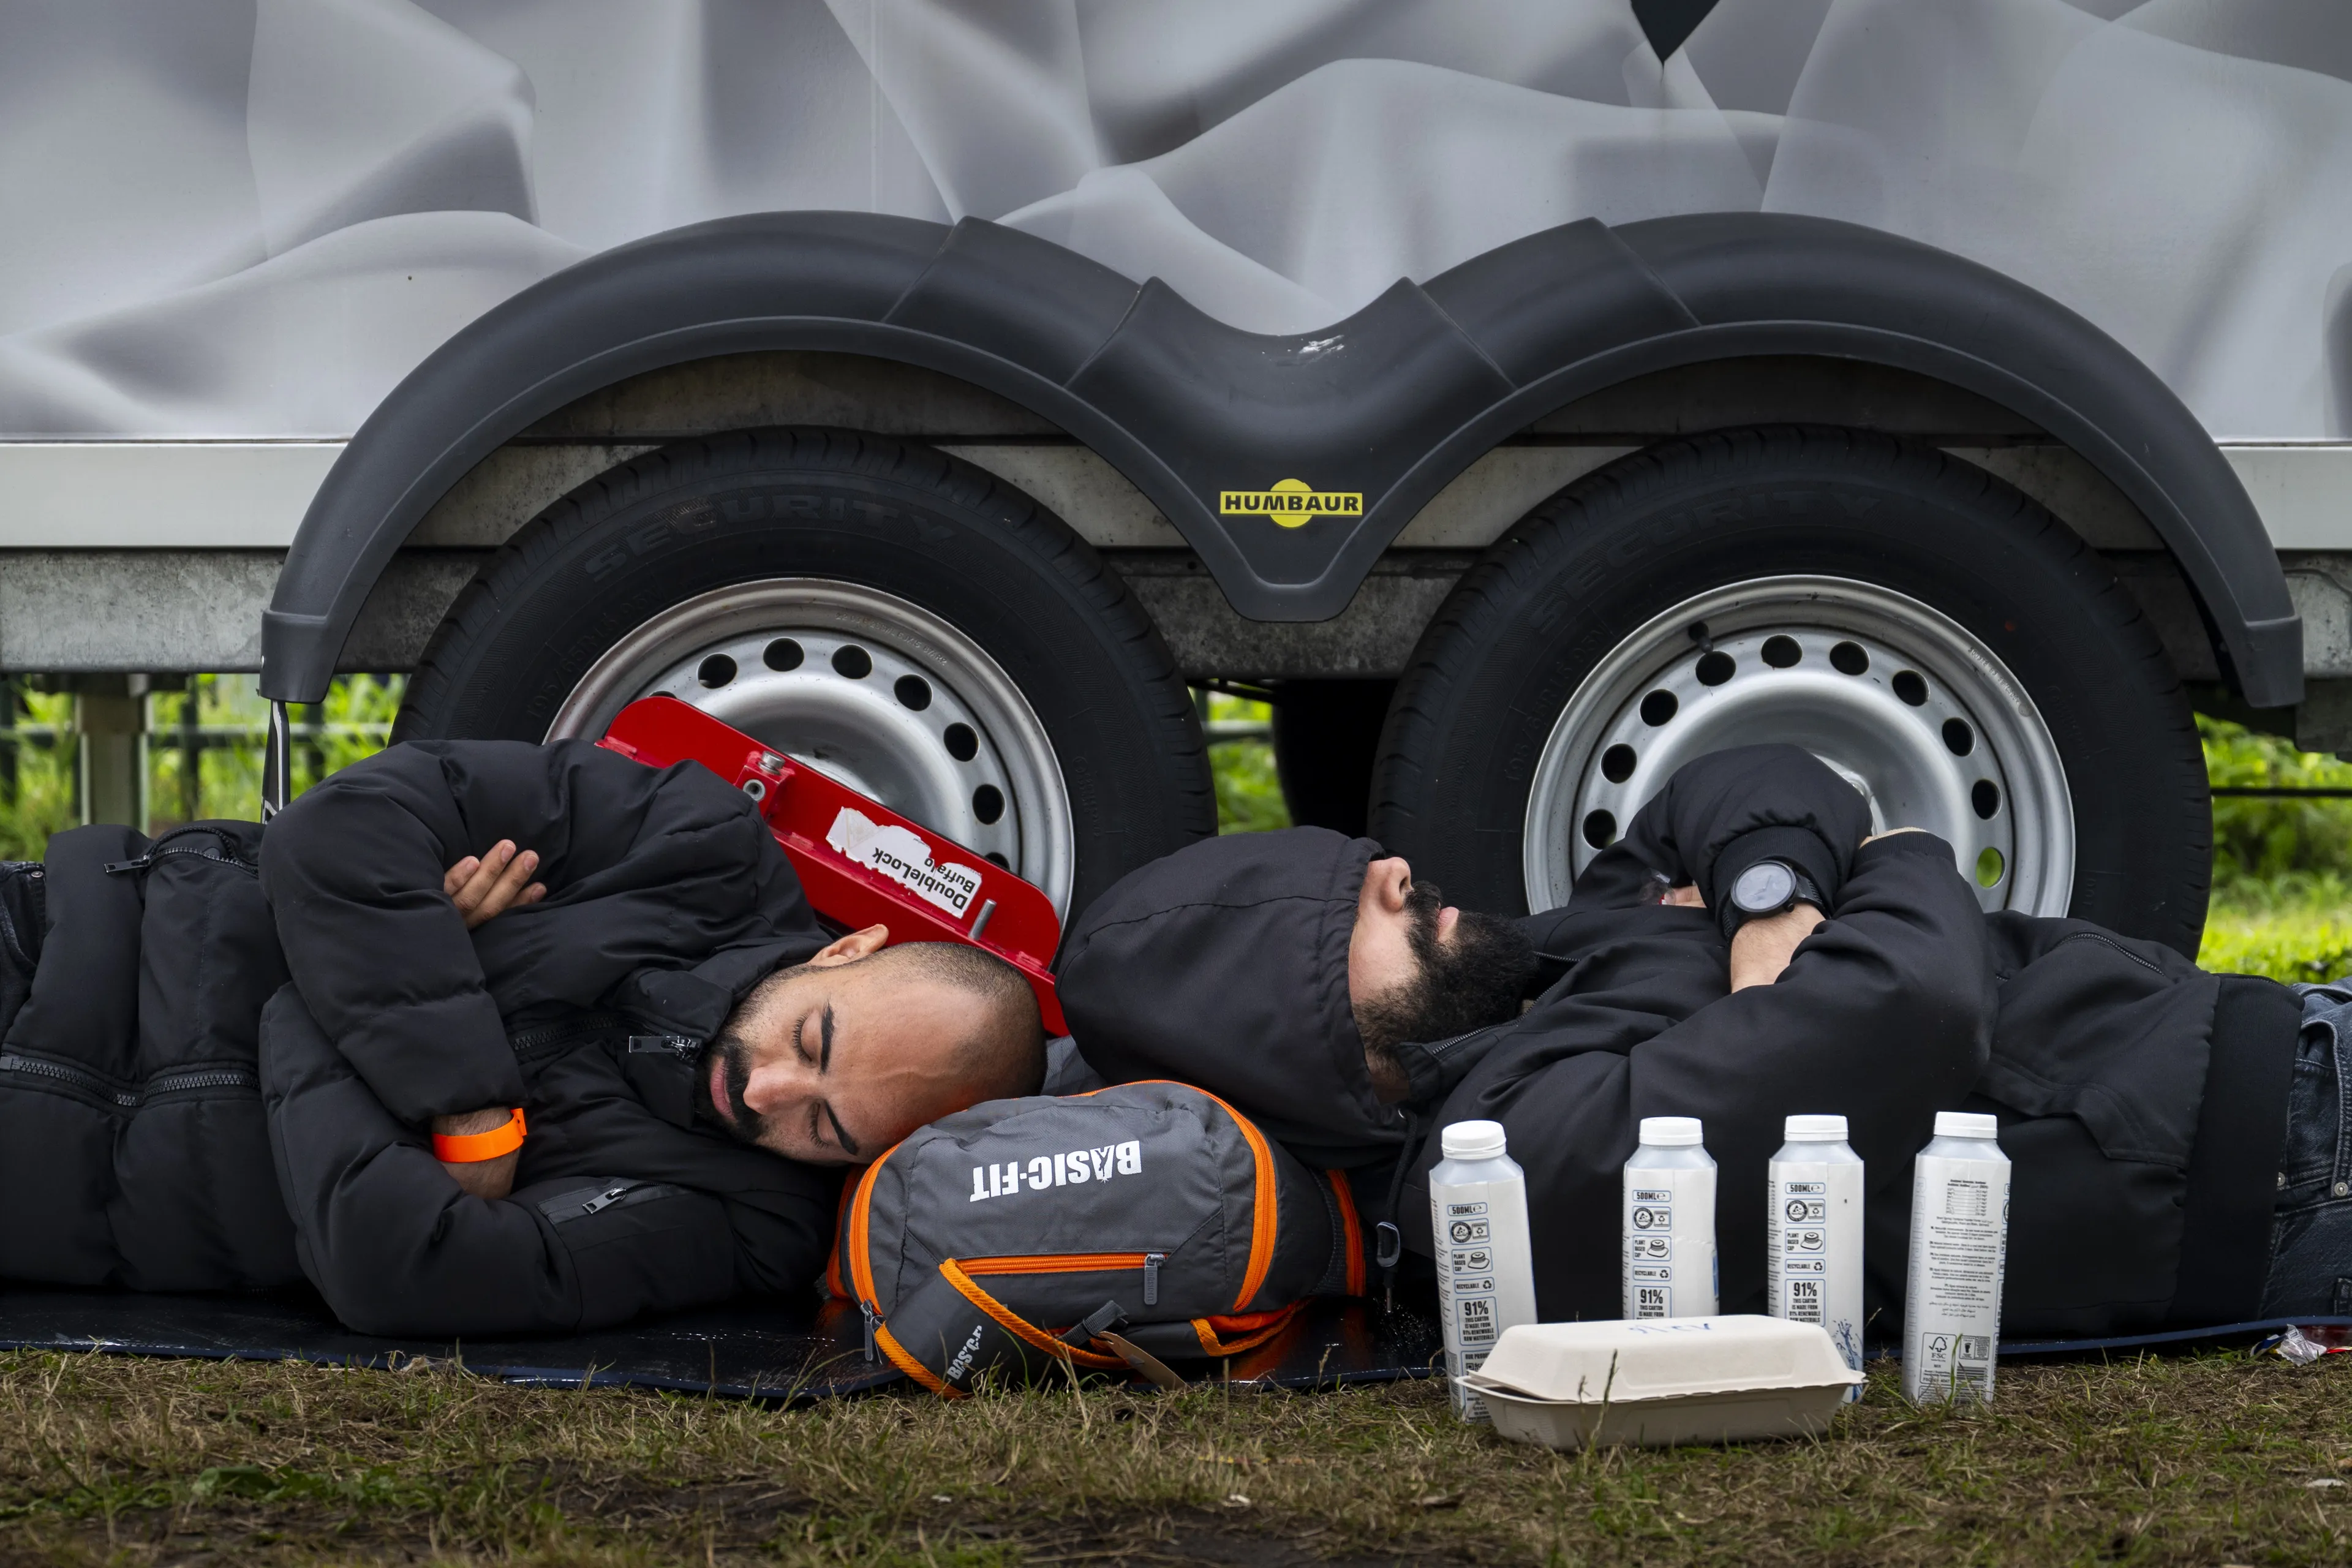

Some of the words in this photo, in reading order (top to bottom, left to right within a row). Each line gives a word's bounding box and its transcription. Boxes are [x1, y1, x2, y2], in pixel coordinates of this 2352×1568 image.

[1226, 495, 1359, 511] HUMBAUR
[585, 493, 957, 582] SECURITY
[1531, 490, 1882, 635] SECURITY
[872, 847, 968, 910] DoubleLock
[970, 1140, 1142, 1202] BASIC-FIT
[1464, 1300, 1489, 1316] 91%
[1640, 1289, 1663, 1304] 91%
[1793, 1283, 1817, 1297] 91%
